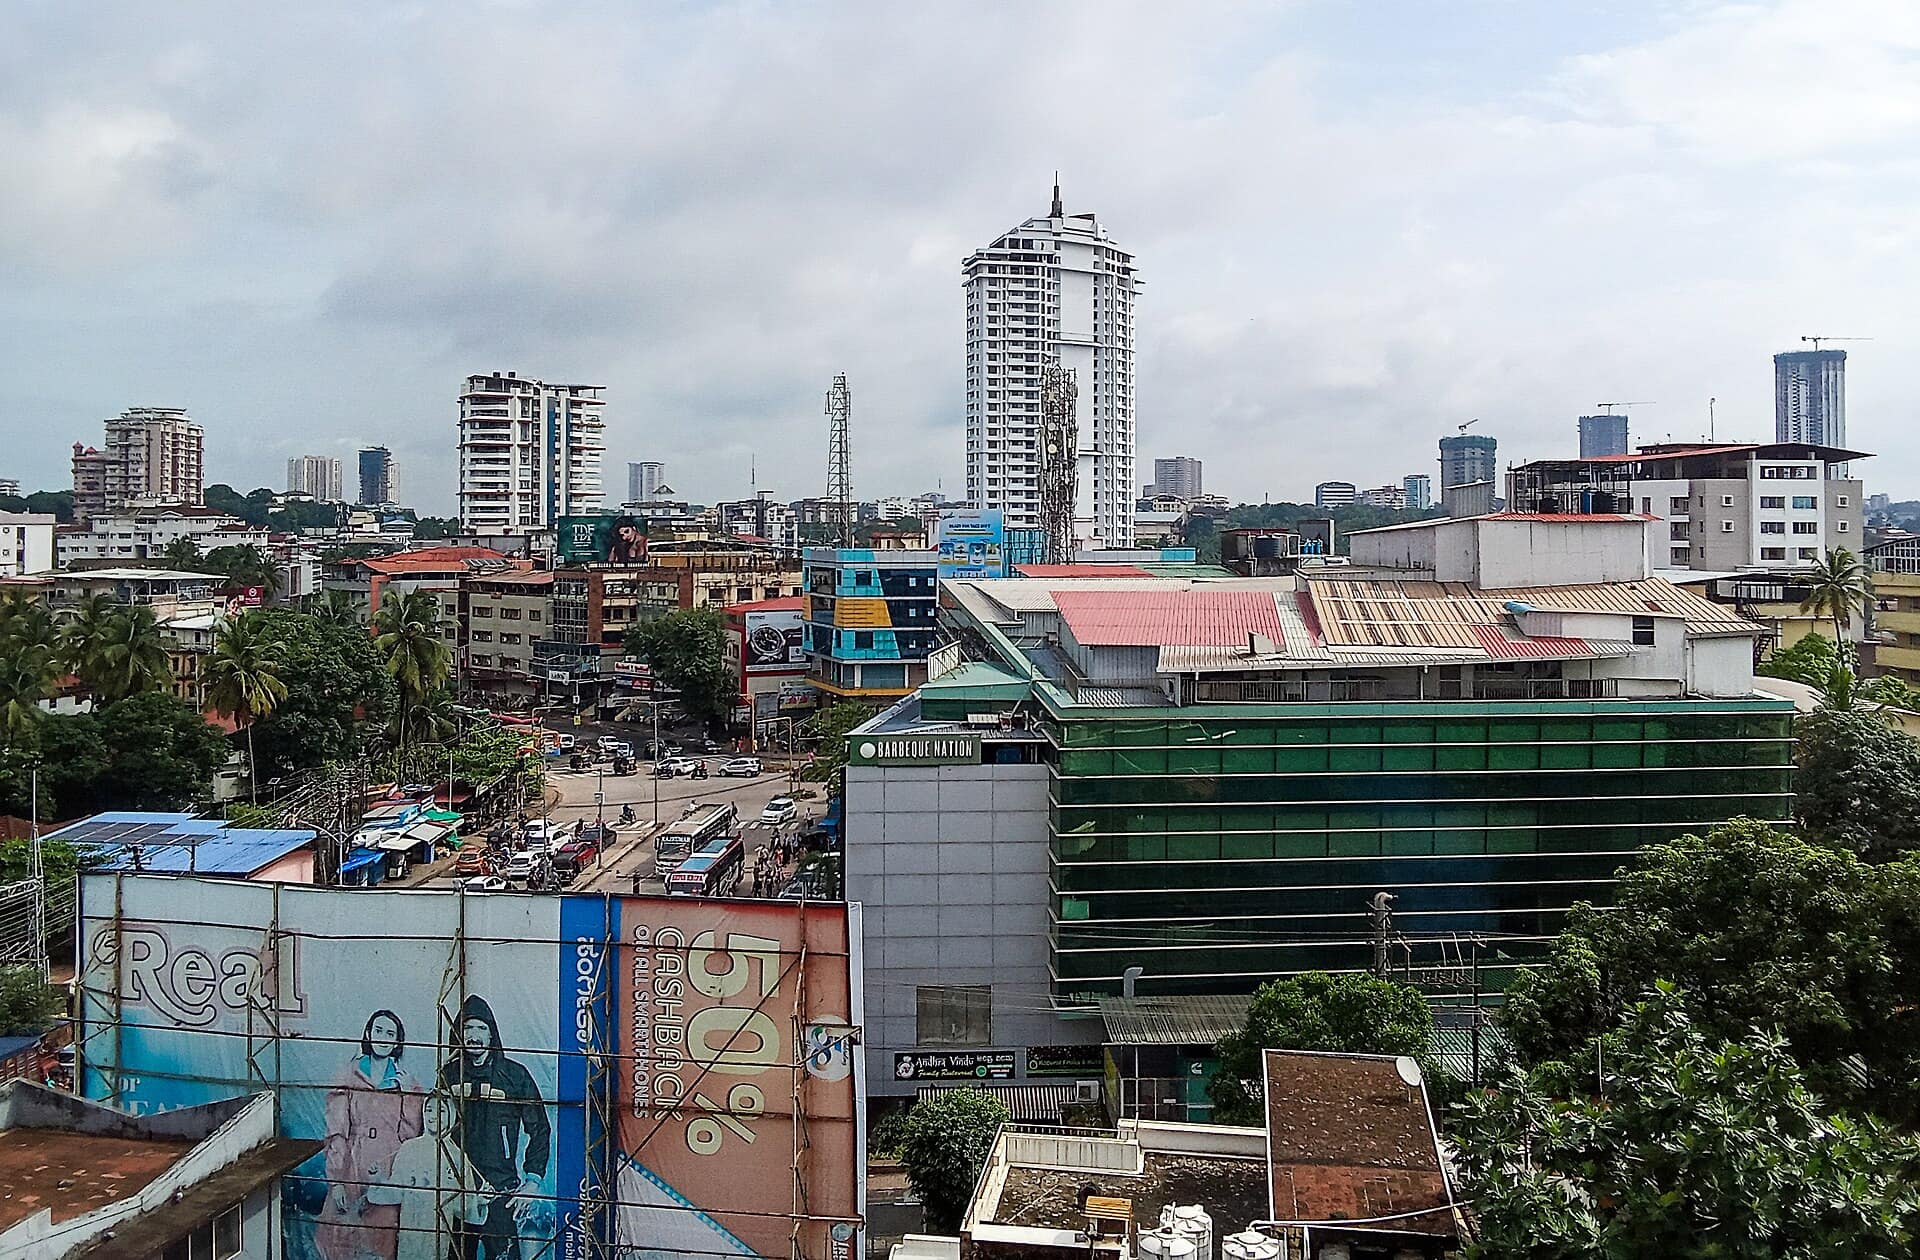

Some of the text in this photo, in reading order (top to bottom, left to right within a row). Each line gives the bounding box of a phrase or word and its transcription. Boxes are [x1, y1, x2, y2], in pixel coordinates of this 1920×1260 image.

[877, 740, 973, 760] BARBEQUE NATION
[93, 929, 304, 1027] Real
[632, 925, 650, 1119] ON ALL SMARTPHONES
[653, 925, 684, 1122] CASHBACK
[686, 928, 781, 1156] 50%
[916, 1054, 974, 1067] Andhra Vindu
